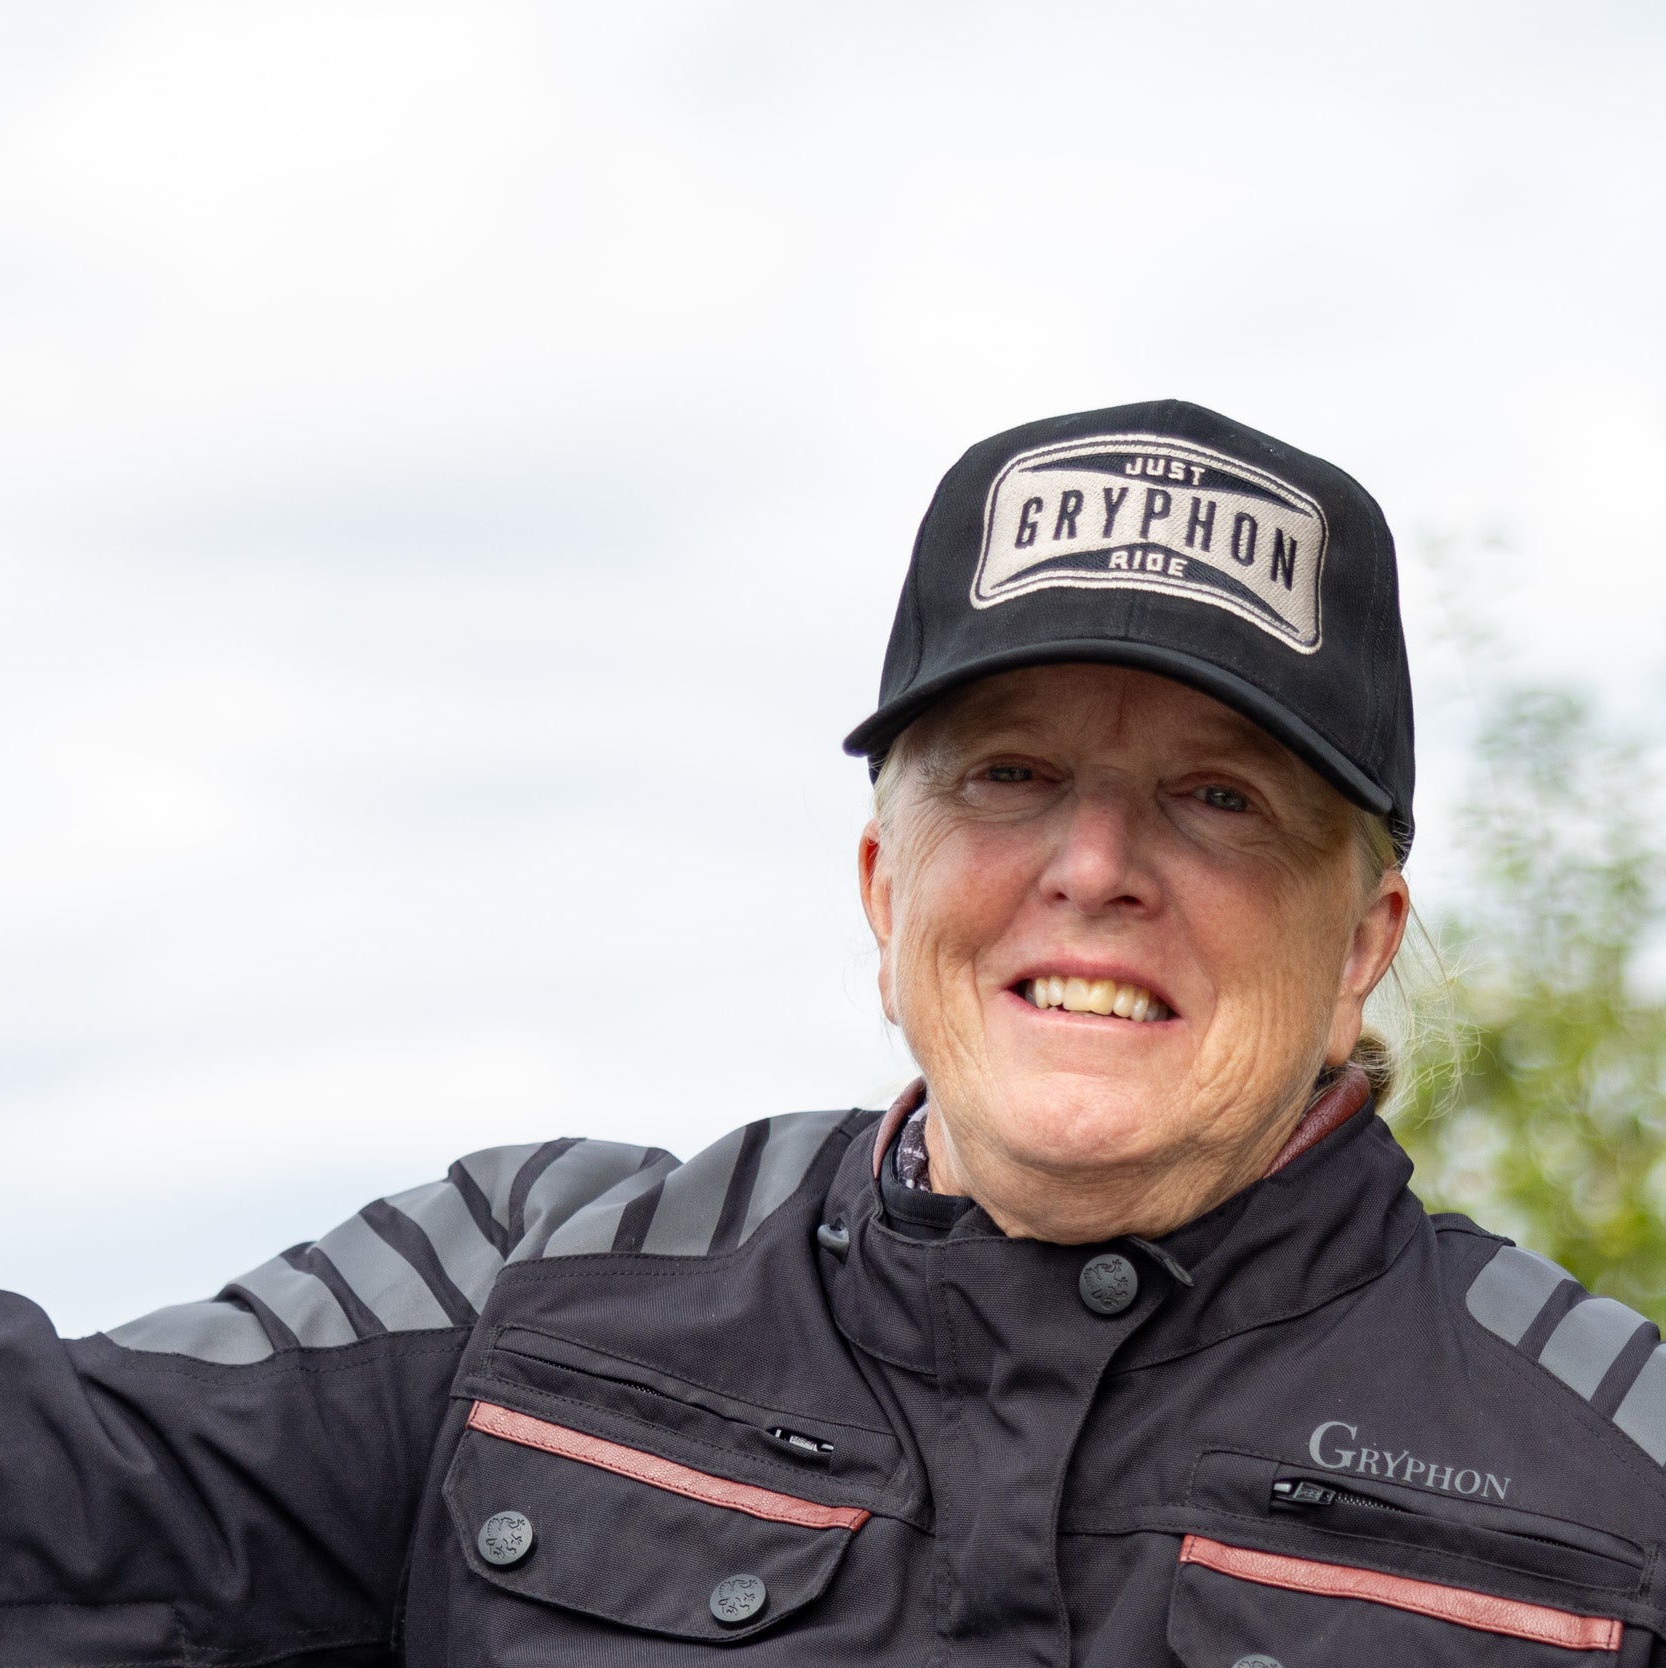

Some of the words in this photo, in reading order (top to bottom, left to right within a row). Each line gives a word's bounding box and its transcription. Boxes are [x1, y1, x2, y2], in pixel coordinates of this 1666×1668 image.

[1125, 458, 1206, 486] JUST
[1014, 486, 1298, 592] GRYPHON
[1108, 551, 1188, 577] RIDE
